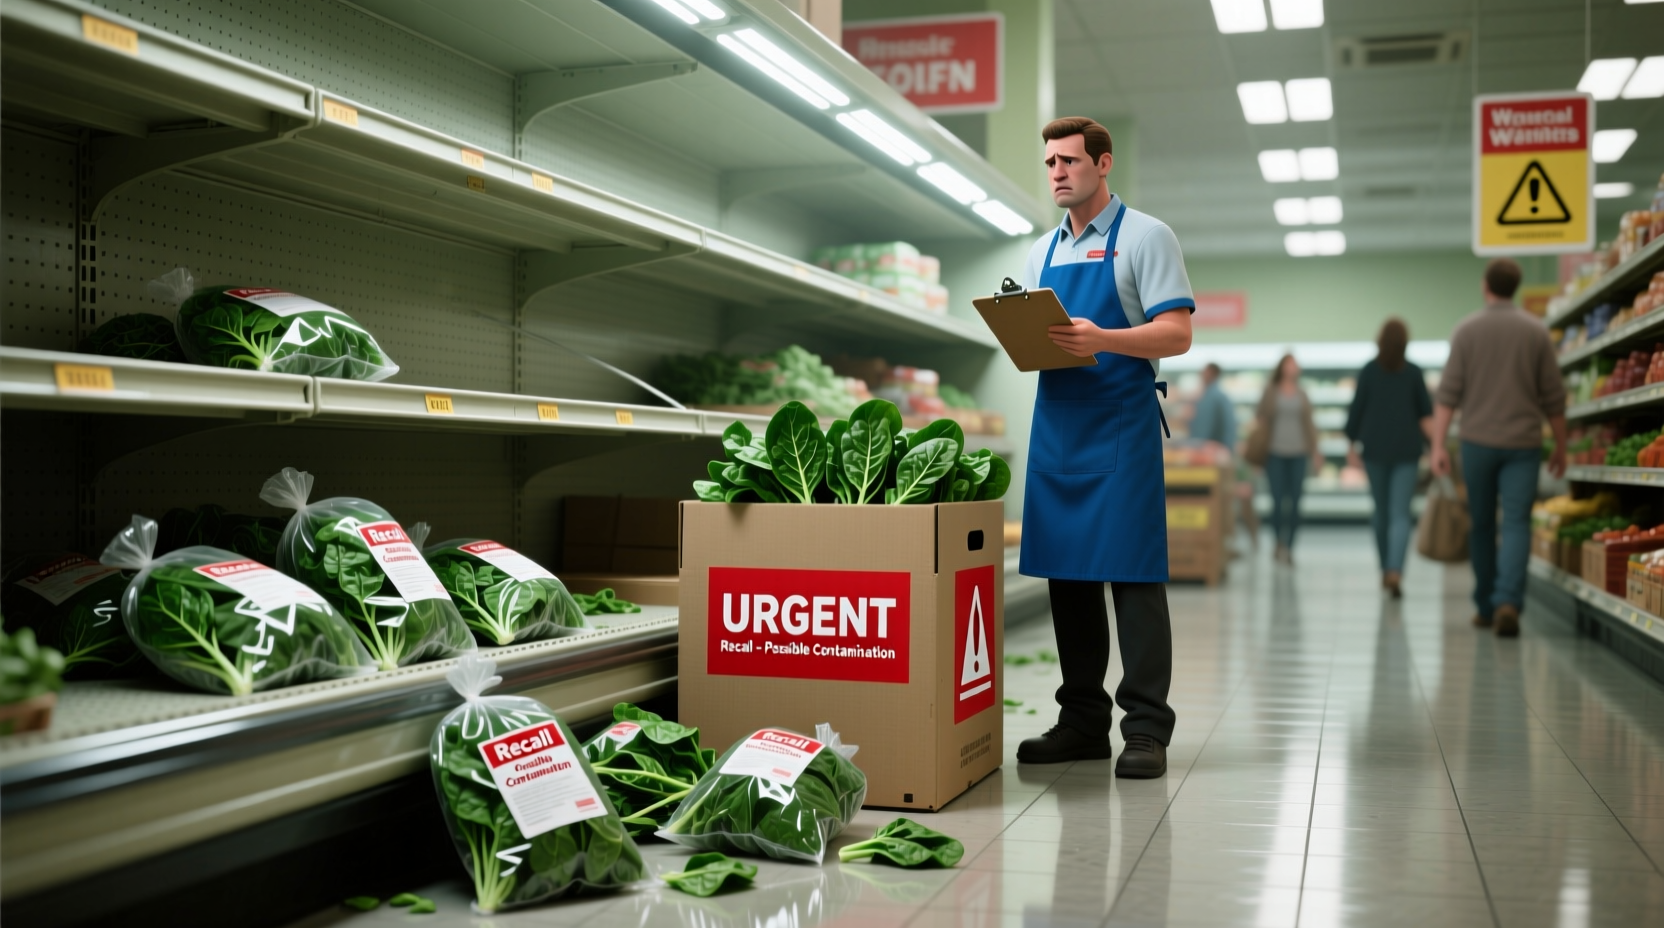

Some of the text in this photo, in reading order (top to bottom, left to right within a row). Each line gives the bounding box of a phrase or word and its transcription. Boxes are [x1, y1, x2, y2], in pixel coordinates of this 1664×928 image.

[722, 592, 897, 639] URGENT
[720, 639, 753, 653] Recall
[813, 643, 896, 660] Contamination
[493, 728, 554, 761] Recall
